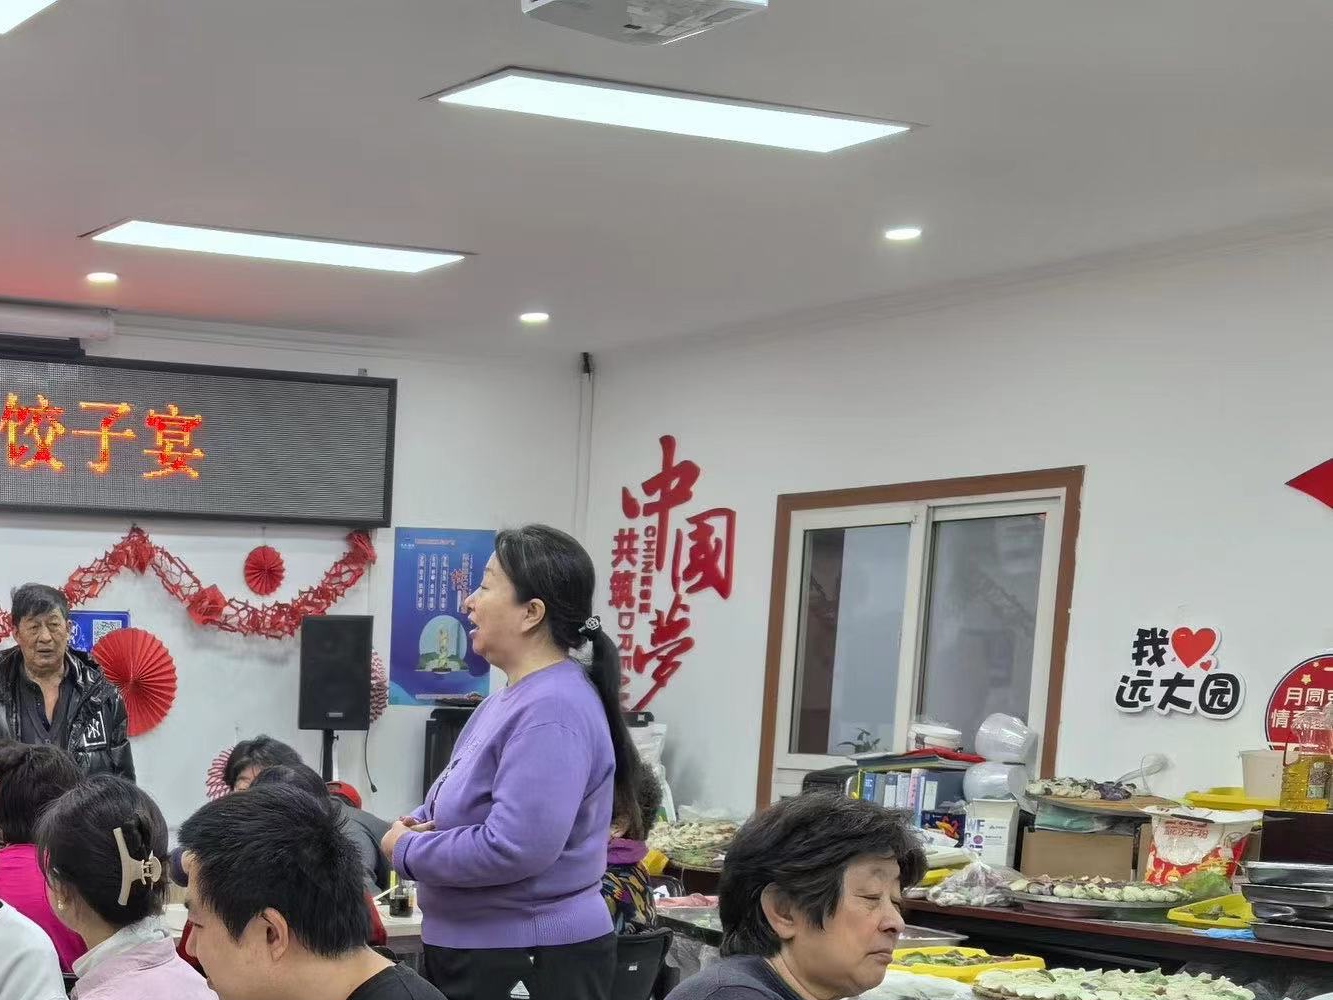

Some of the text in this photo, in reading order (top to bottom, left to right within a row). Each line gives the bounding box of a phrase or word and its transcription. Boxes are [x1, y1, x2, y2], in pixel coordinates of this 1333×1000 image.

[608, 527, 640, 610] 共筑
[621, 434, 737, 712] 中国梦
[1131, 627, 1170, 668] 我
[1114, 669, 1241, 716] 远大园
